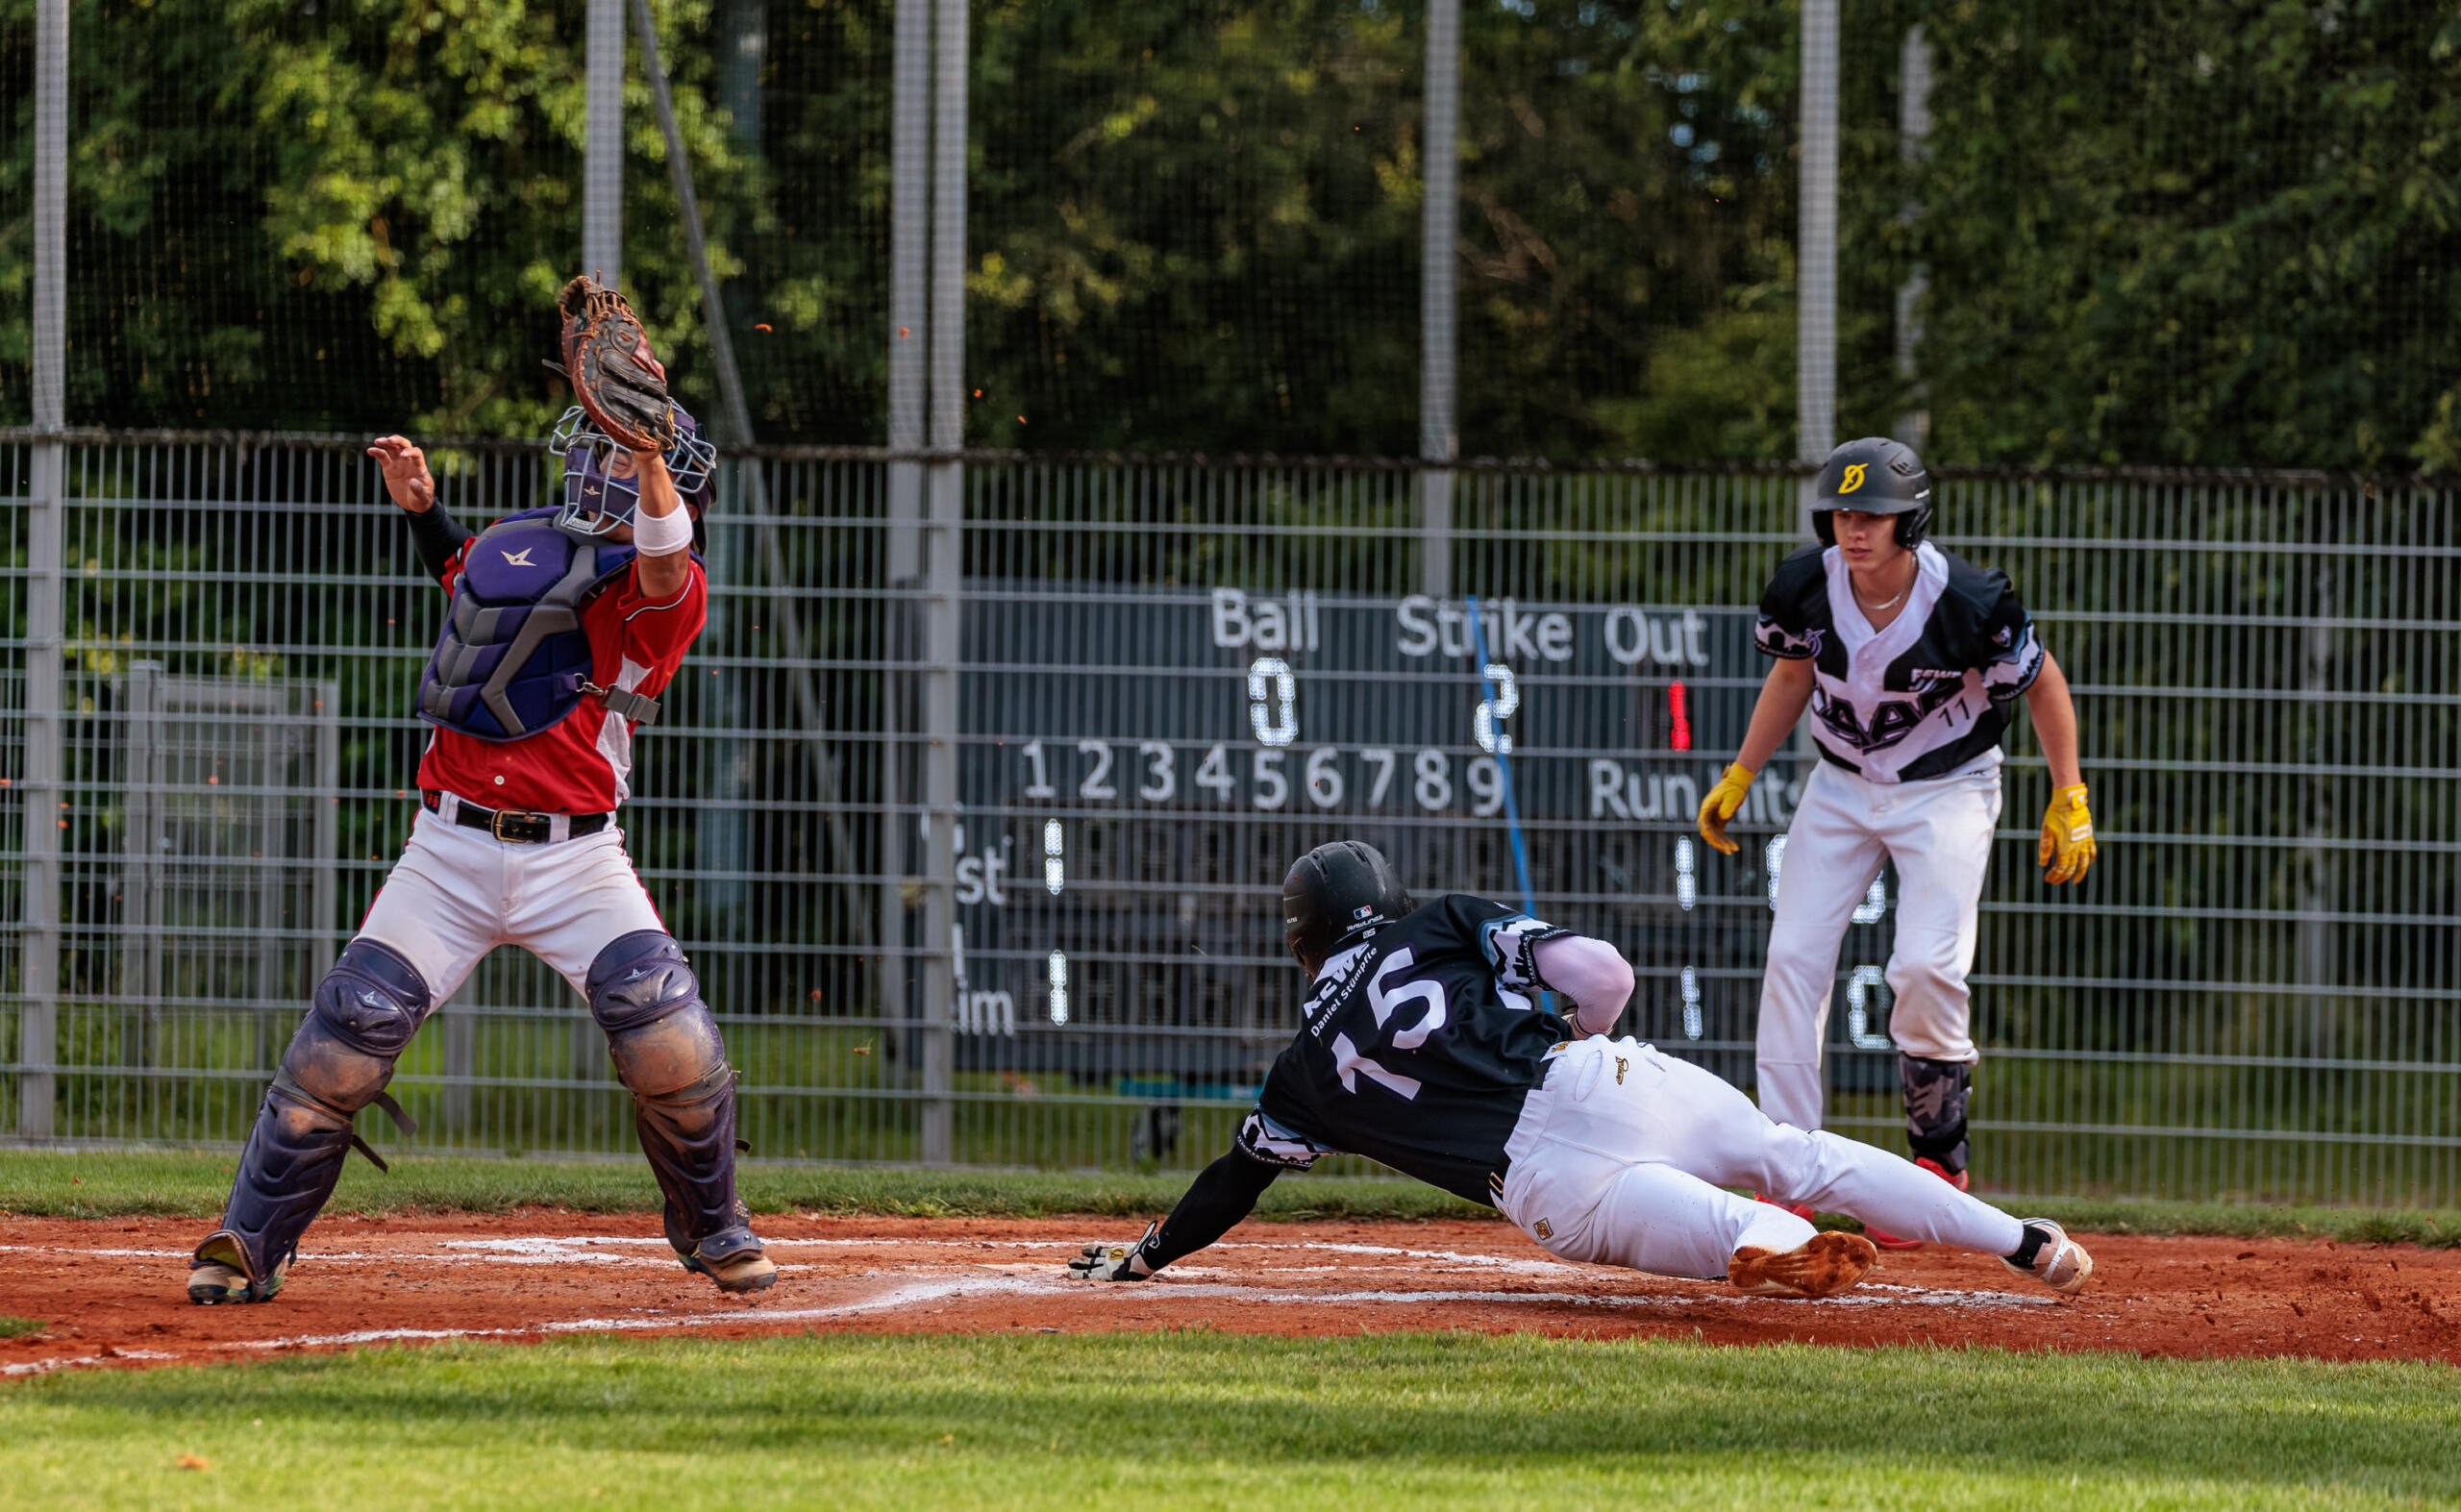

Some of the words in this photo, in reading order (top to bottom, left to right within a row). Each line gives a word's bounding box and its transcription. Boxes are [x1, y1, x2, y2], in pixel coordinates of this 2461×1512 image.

[1211, 587, 1318, 652] Ball
[1397, 594, 1573, 660] Strike
[1604, 604, 1708, 665] Out
[1248, 657, 1298, 746] 0
[1474, 663, 1519, 754] 2
[1669, 680, 1691, 752] 1
[1022, 738, 1056, 799] 1
[1078, 739, 1117, 800] 2
[1139, 740, 1176, 802] 3
[1195, 742, 1236, 803] 4
[1253, 747, 1288, 810] 5
[1305, 746, 1344, 808] 6
[1359, 748, 1396, 808] 7
[1414, 747, 1452, 811] 8
[1466, 756, 1505, 817] 9
[1589, 758, 1696, 822] Run
[1044, 818, 1064, 895] 1
[1675, 835, 1696, 910] 1
[1049, 950, 1068, 1026] 1
[1680, 965, 1703, 1040] 1
[1310, 998, 1342, 1038] Daniel
[1340, 947, 1378, 1001] Stümpfle
[1330, 946, 1447, 1102] 15
